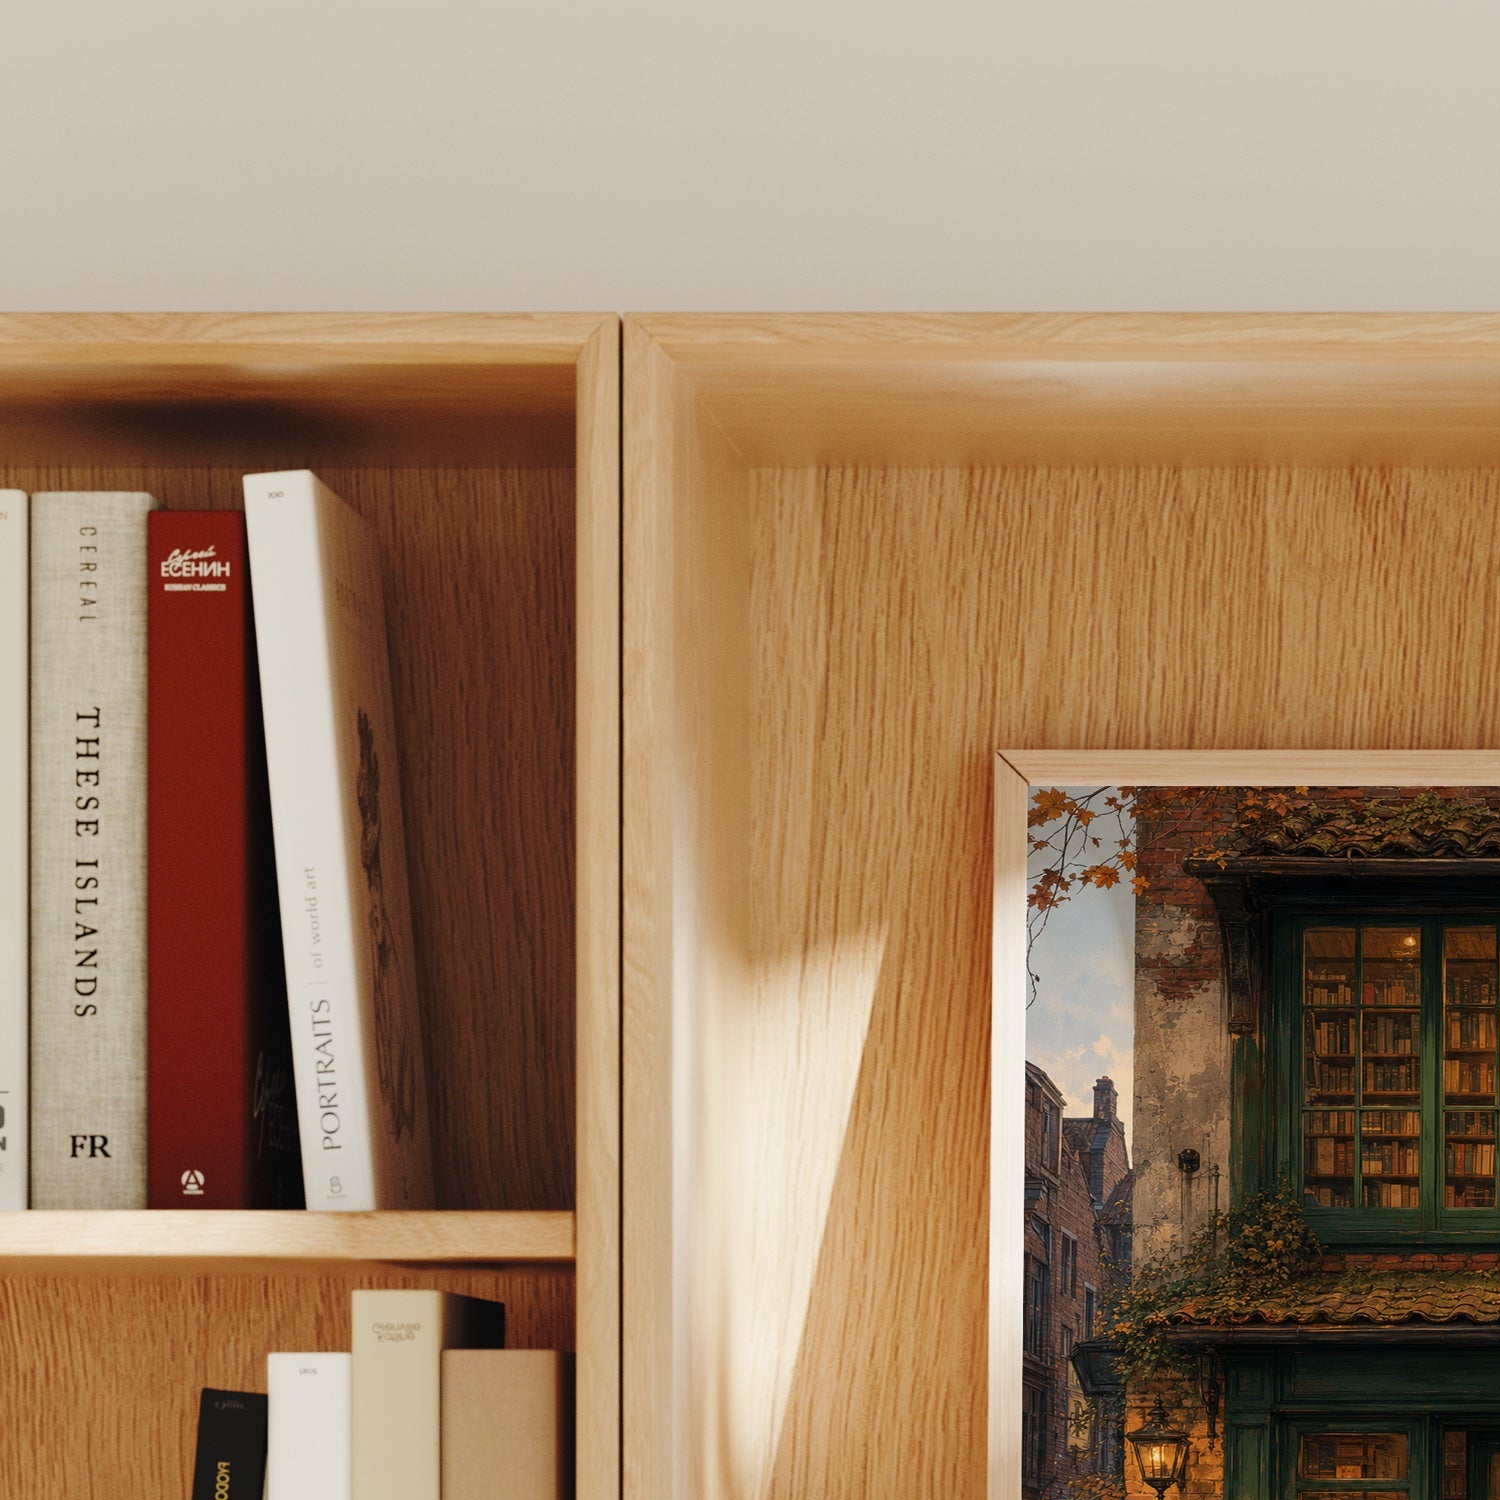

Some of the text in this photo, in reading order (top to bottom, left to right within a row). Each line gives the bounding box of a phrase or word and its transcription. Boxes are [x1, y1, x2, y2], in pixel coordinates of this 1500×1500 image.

[79, 526, 98, 622] CEREAL
[160, 561, 231, 577] ЕСЕНИН
[74, 706, 100, 1017] THESE ISLANDS
[304, 866, 342, 1151] PORTRAITS of world art
[70, 1134, 112, 1158] FR
